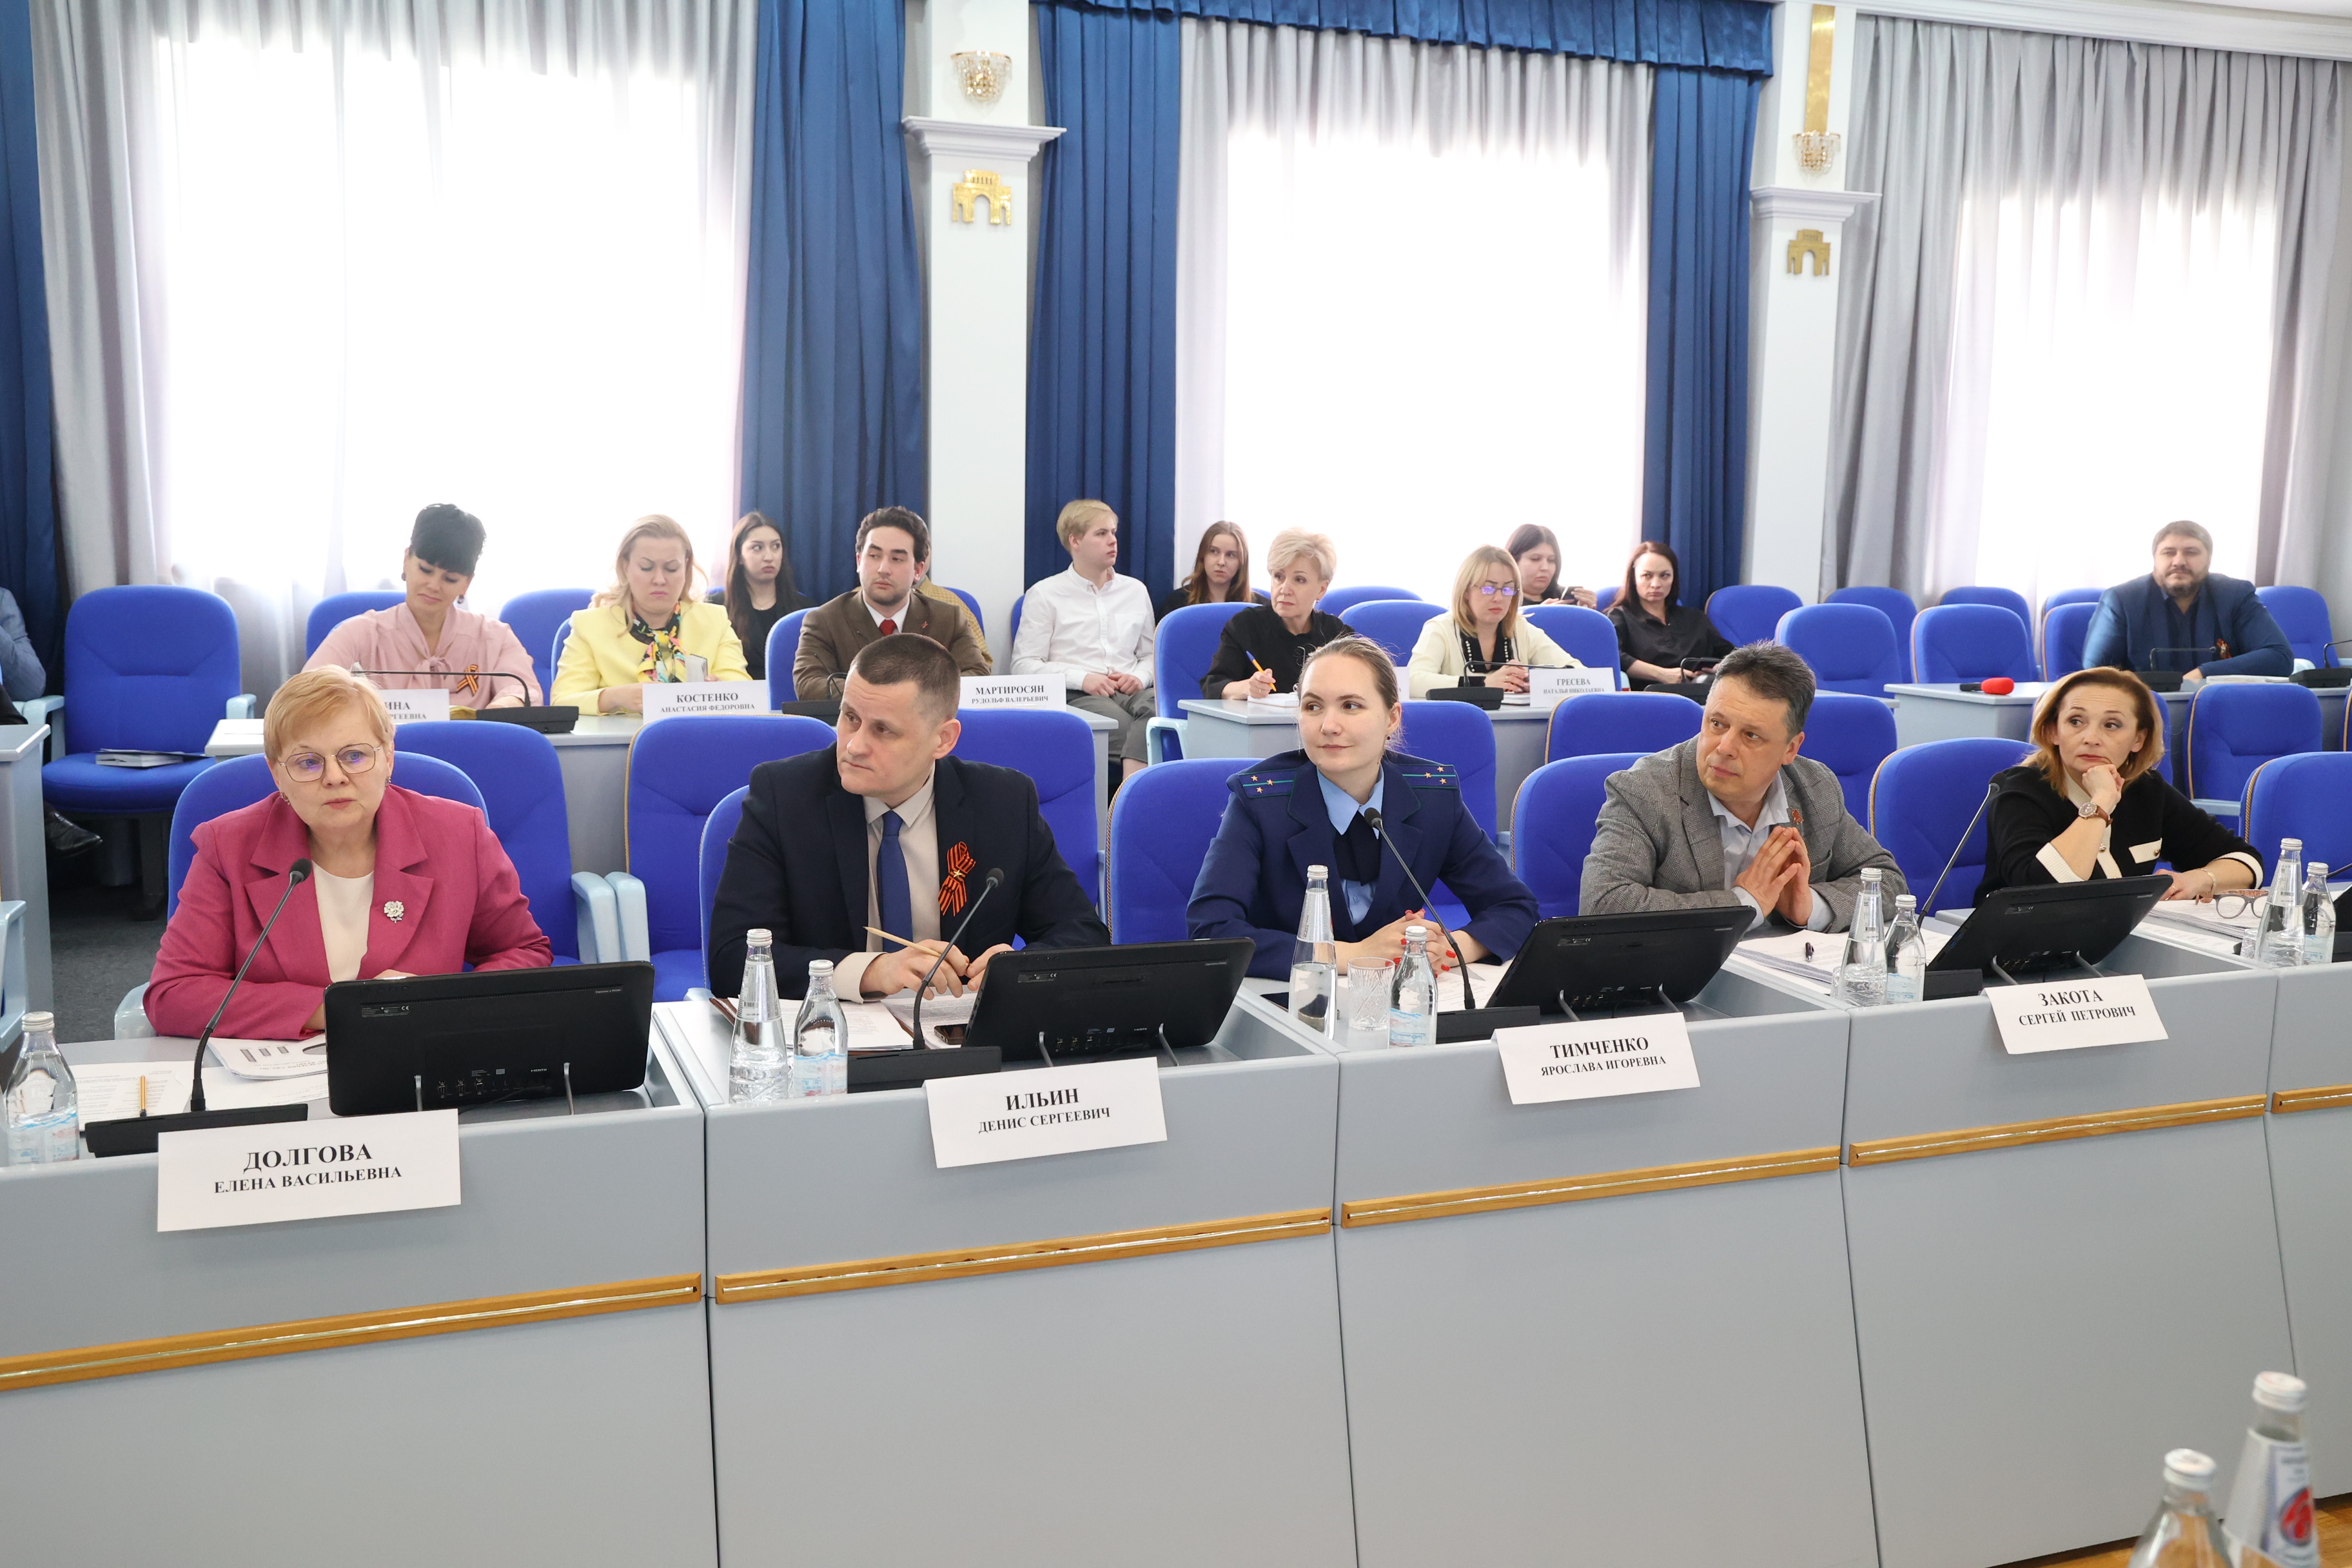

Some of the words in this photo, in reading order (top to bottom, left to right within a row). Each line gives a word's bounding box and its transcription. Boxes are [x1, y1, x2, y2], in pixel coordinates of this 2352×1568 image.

[677, 692, 738, 703] КОСТЕНКО
[975, 685, 1044, 695] МАРТИРОСЯН
[384, 701, 411, 710] ИНА
[2038, 990, 2104, 1006] ЗАКОТА
[2019, 1010, 2066, 1026] СЕРГЕЙ
[2070, 1006, 2136, 1021] ПЕТРОВИЧ
[1550, 1037, 1649, 1059] ТИМЧЕНКО
[1541, 1062, 1603, 1076] ЯРОСЛАВА
[1605, 1055, 1666, 1070] ИГОРЕВНА
[1005, 1088, 1080, 1111] ИЛЬИН
[979, 1117, 1026, 1134] ДЕНИС
[1030, 1107, 1111, 1126] СЕРГЕЕВИЧ
[243, 1143, 373, 1174] ДОЛГОВА
[214, 1177, 277, 1193] ЕЛЕНА
[282, 1166, 402, 1188] ВАСИЛЬЕВНА
